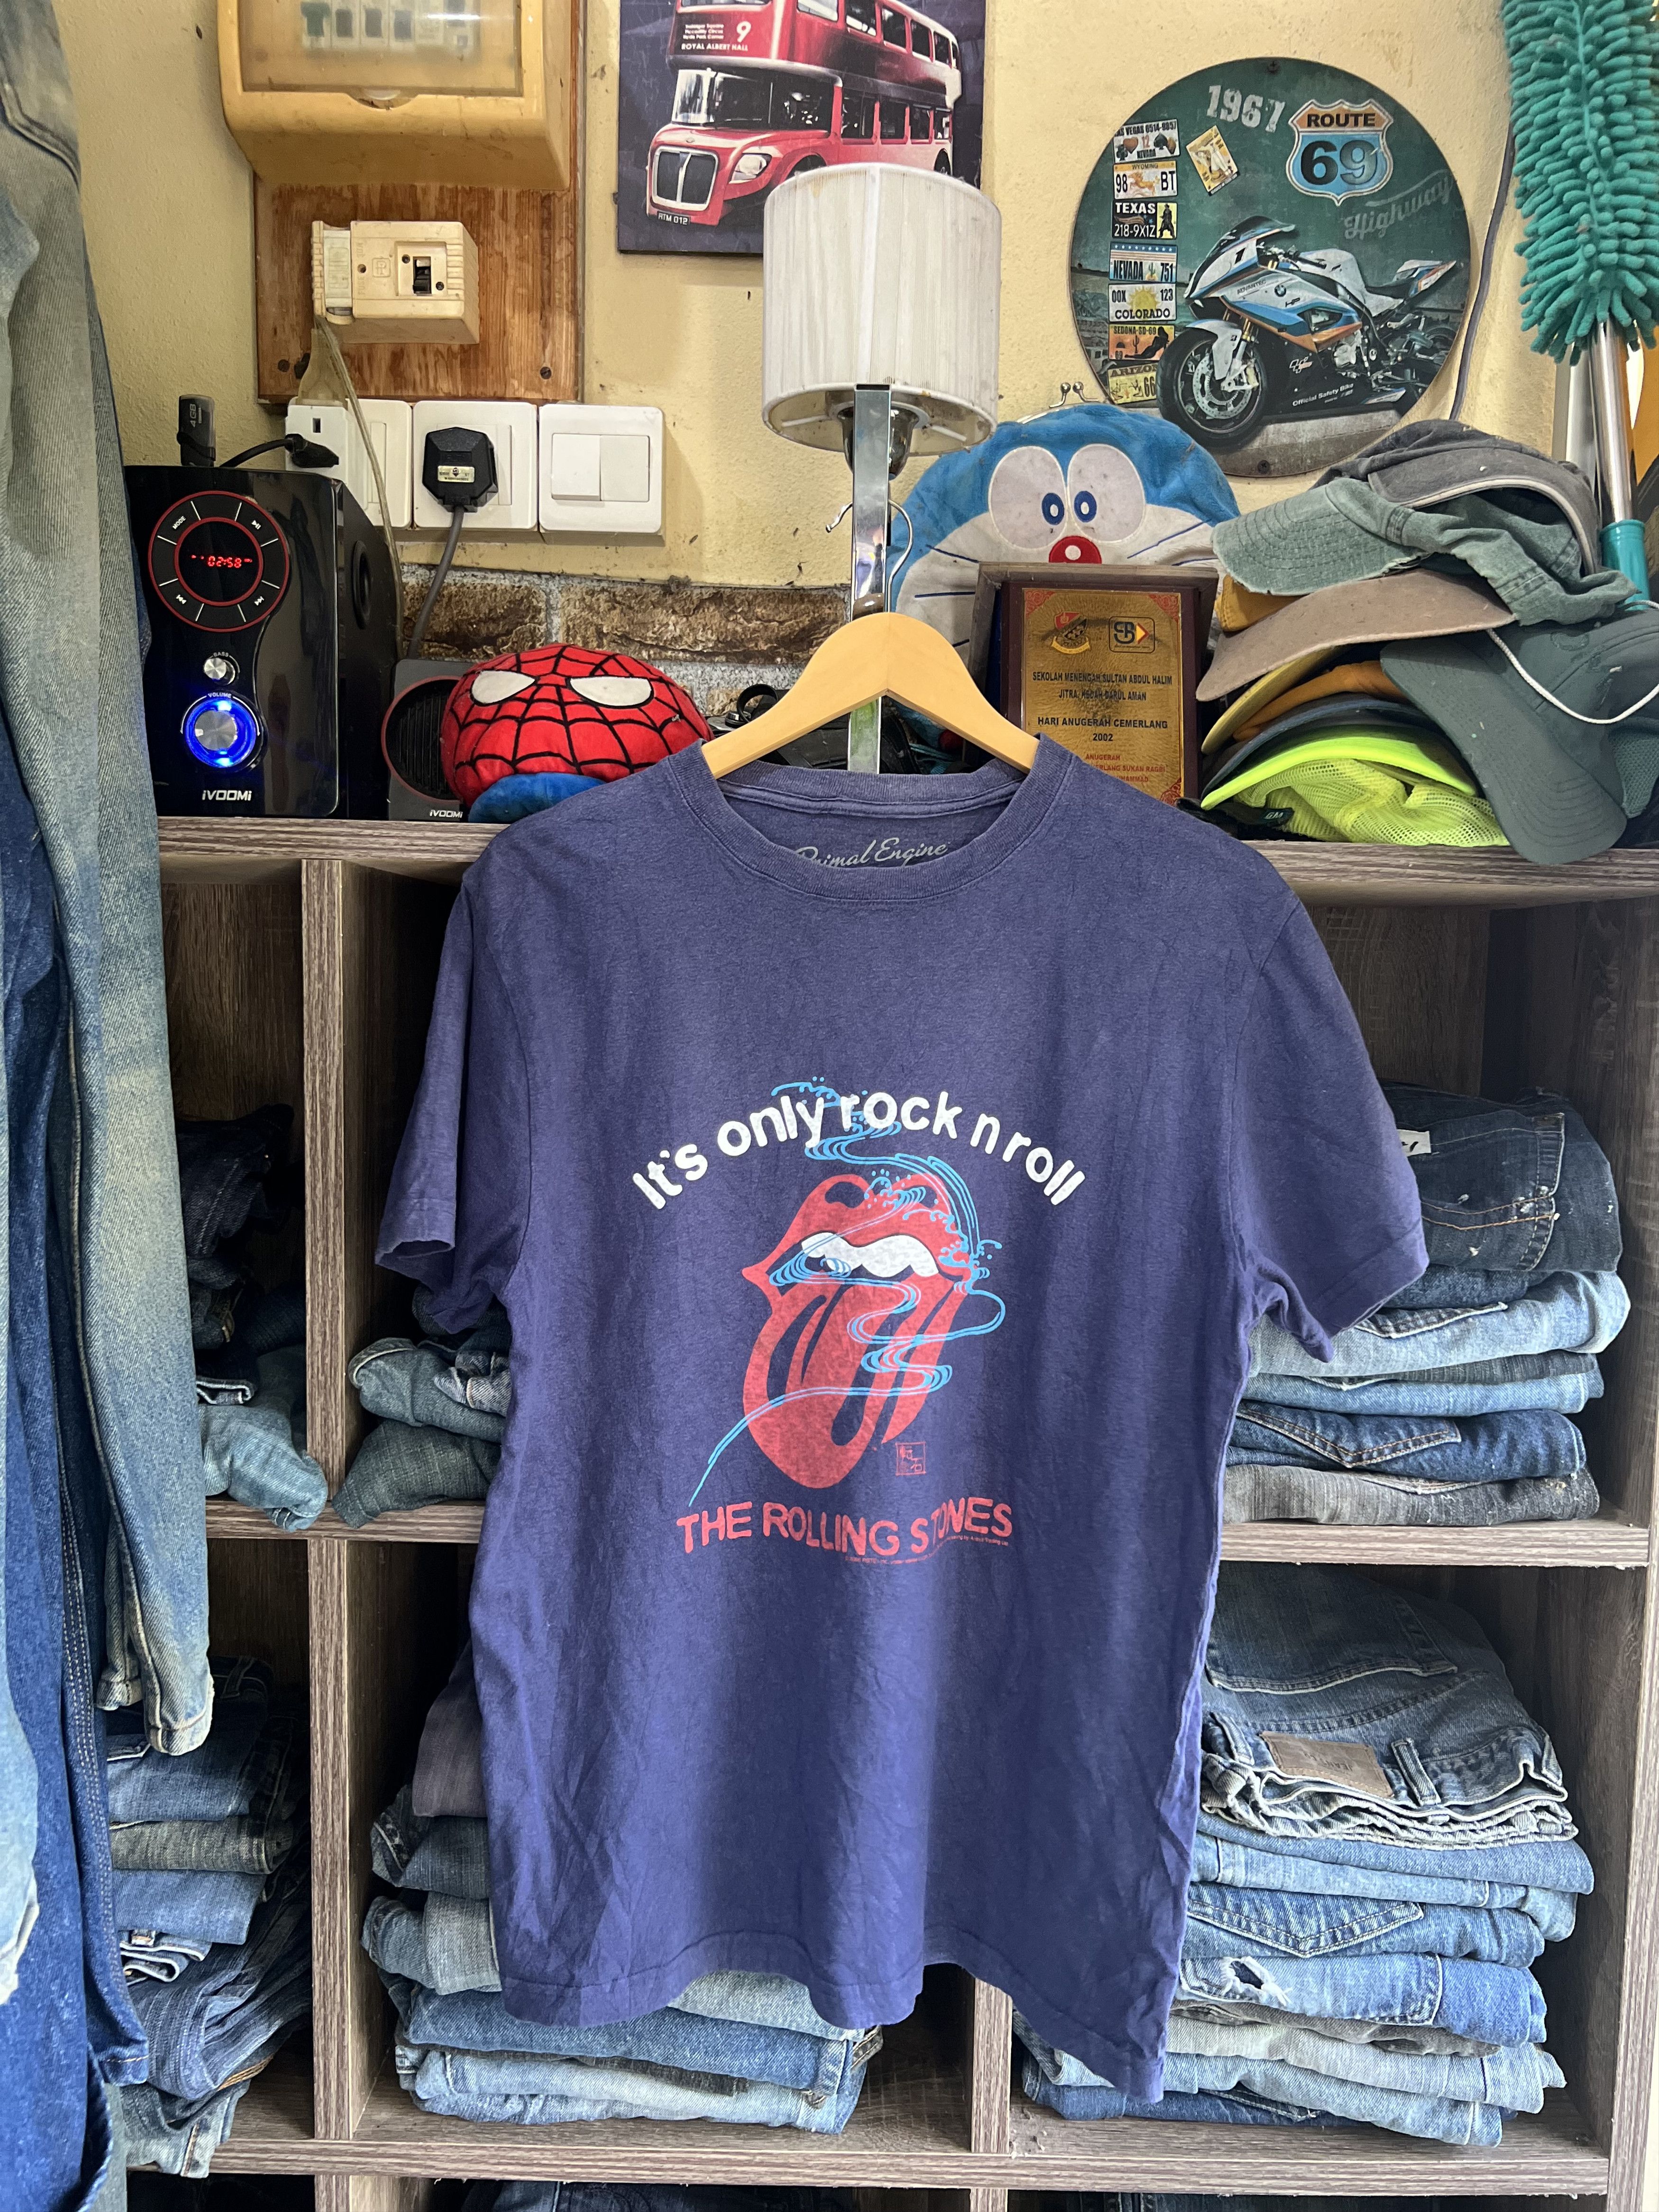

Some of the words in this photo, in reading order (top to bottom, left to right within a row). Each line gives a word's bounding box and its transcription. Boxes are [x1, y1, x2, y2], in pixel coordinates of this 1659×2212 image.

[736, 21, 751, 43] 9
[1206, 85, 1285, 133] 1967
[1307, 113, 1376, 127] ROUTE
[1125, 125, 1144, 136] VEGAS
[1141, 135, 1150, 148] 12
[1300, 139, 1378, 185] 69
[1116, 173, 1128, 193] 98
[1161, 171, 1176, 191] BT
[1115, 202, 1156, 214] TEXAS
[1344, 170, 1455, 240] Highway
[658, 212, 672, 222] RTM
[673, 216, 688, 225] 012
[1114, 224, 1156, 237] 218-9X1Z
[1114, 260, 1143, 280] NEVADA
[1160, 263, 1173, 282] 751
[1160, 288, 1173, 301] 123
[1115, 308, 1170, 319] COLORADO
[1144, 376, 1156, 397] 66
[1292, 394, 1317, 406] Official
[1318, 389, 1339, 399] Safety
[172, 516, 186, 529] MODE
[208, 555, 242, 568] 02:58
[1033, 672, 1063, 681] SEKOLAH
[1065, 672, 1101, 682] MENENGAH
[1103, 674, 1127, 683] SULTAN
[1129, 674, 1150, 684] ABDUL
[1152, 675, 1172, 685] HALIM
[1105, 691, 1126, 700] DARUL
[1128, 692, 1147, 701] AMAN
[1038, 717, 1059, 725] HARI
[1062, 718, 1111, 727] ANUGERAH
[1114, 719, 1168, 729] CEMERLANG
[1093, 733, 1113, 741] 2002
[202, 790, 252, 801] iVOOMi
[429, 809, 463, 819] iVOOMi
[874, 837, 949, 867] Engine
[632, 1144, 708, 1210] It's
[717, 1095, 824, 1156] only
[840, 1091, 962, 1139] rock
[970, 1113, 1000, 1155] n
[1002, 1131, 1085, 1206] roll
[676, 1501, 753, 1554] THE
[763, 1501, 900, 1556] ROLLING
[911, 1496, 1012, 1554] STONES
